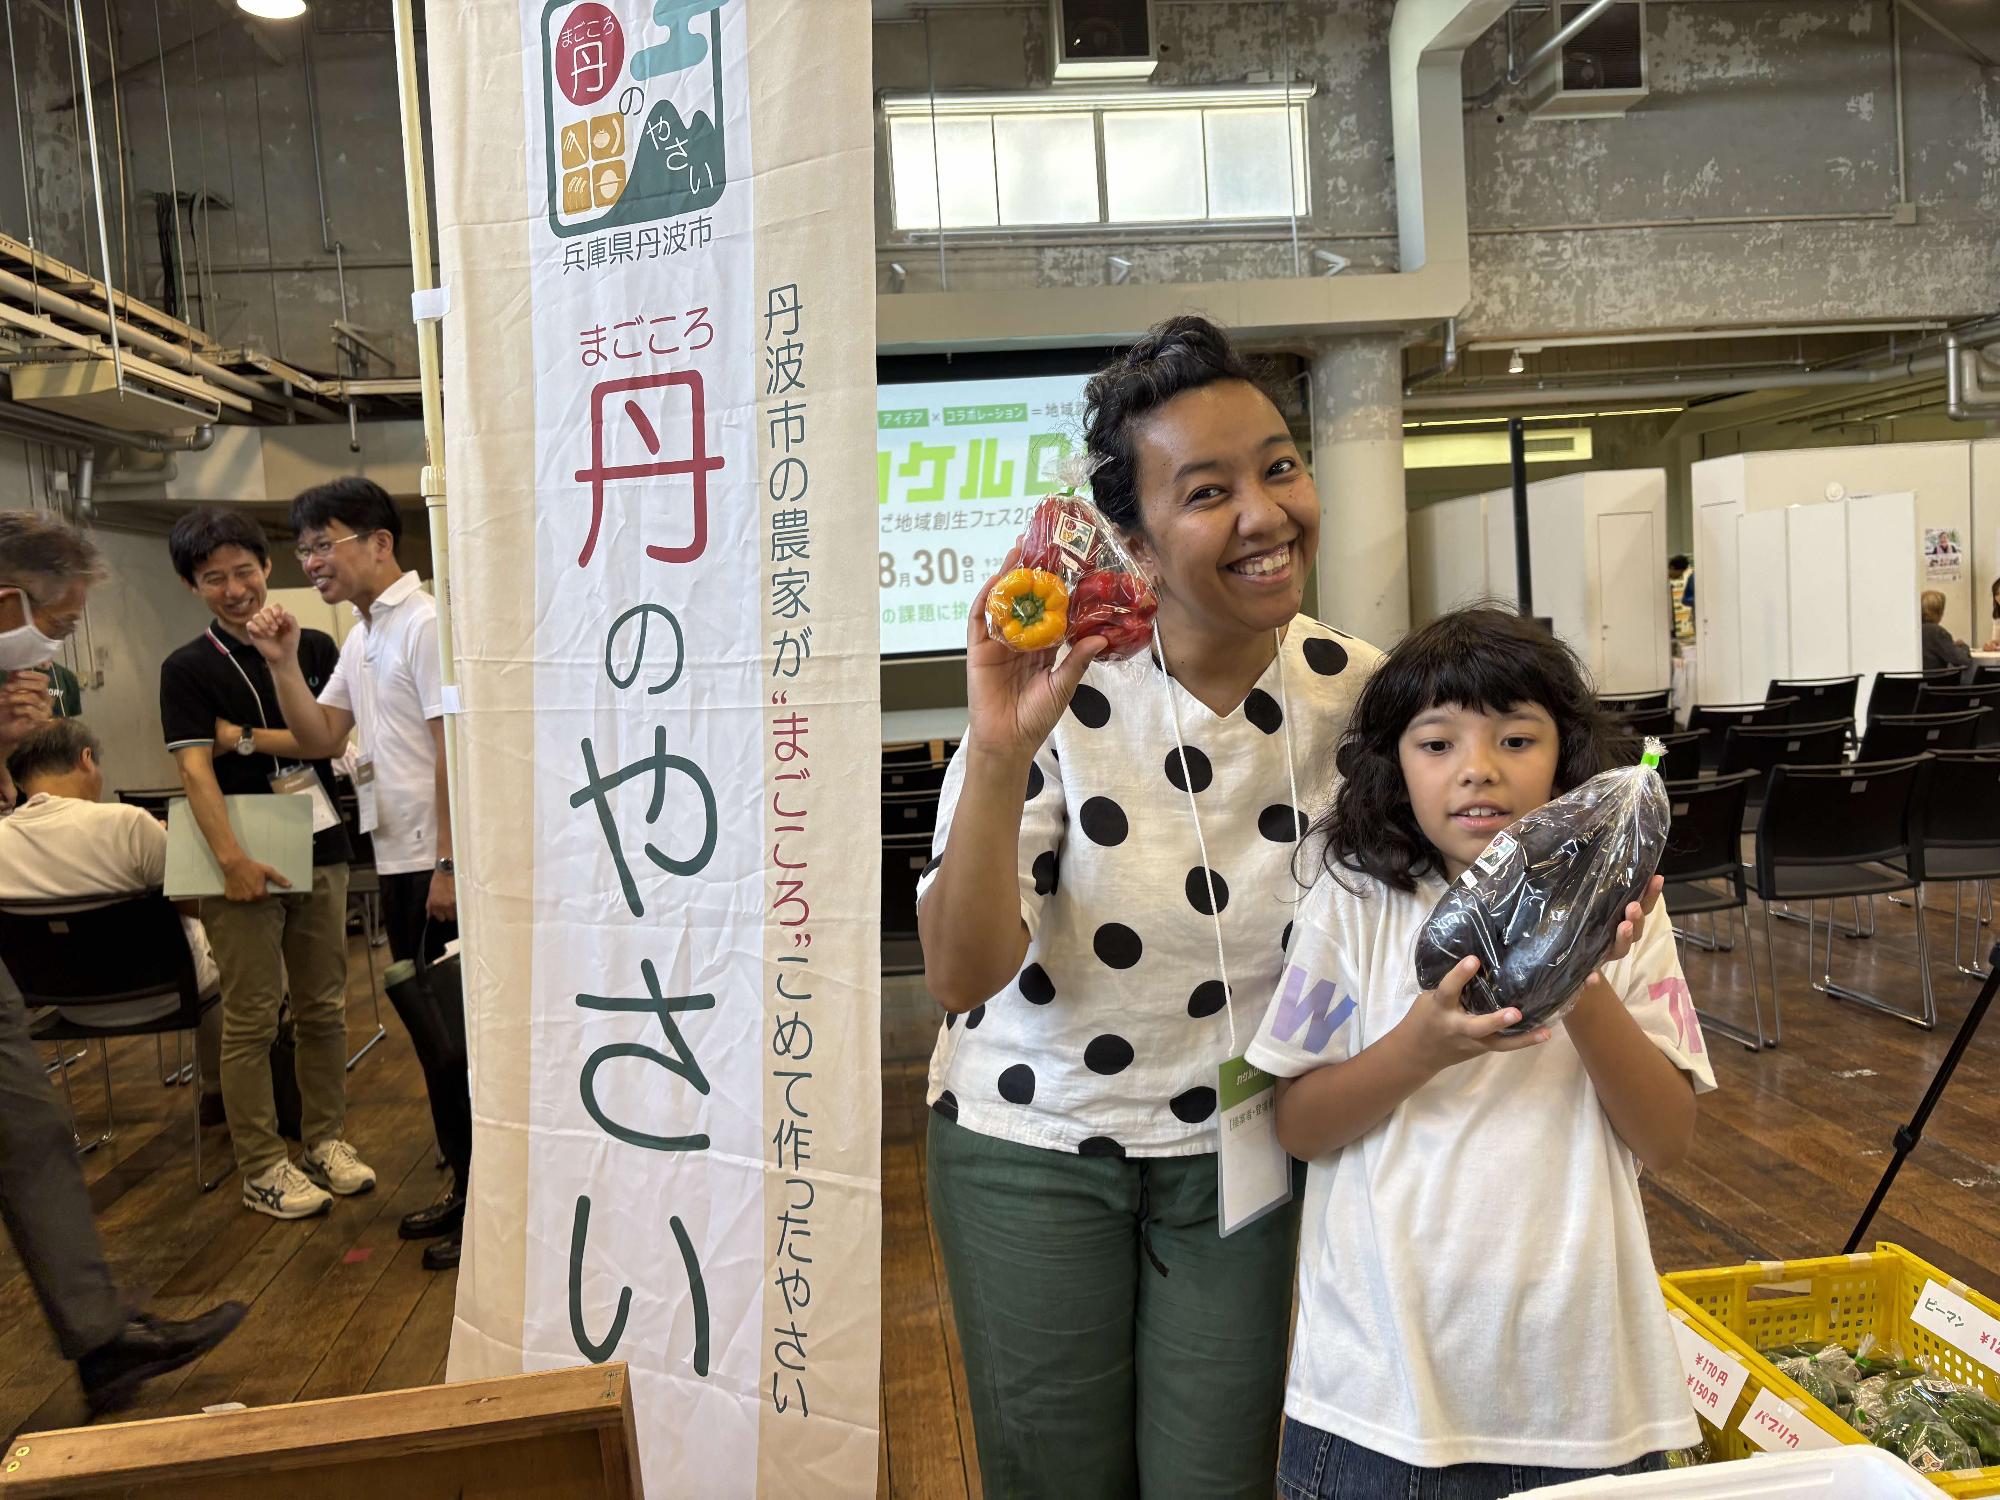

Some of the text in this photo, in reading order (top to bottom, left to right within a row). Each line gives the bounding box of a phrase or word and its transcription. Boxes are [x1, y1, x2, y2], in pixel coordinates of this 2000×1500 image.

[561, 15, 615, 48] まごころ
[571, 41, 607, 98] 丹
[646, 115, 714, 195] やさい
[562, 215, 713, 275] 兵庫県丹波市
[579, 306, 714, 366] まごころ
[883, 412, 923, 425] アイデア
[946, 407, 1024, 423] コラボレーション
[569, 368, 725, 1377] 丹のやさい
[1924, 1297, 1965, 1327] ピーマン
